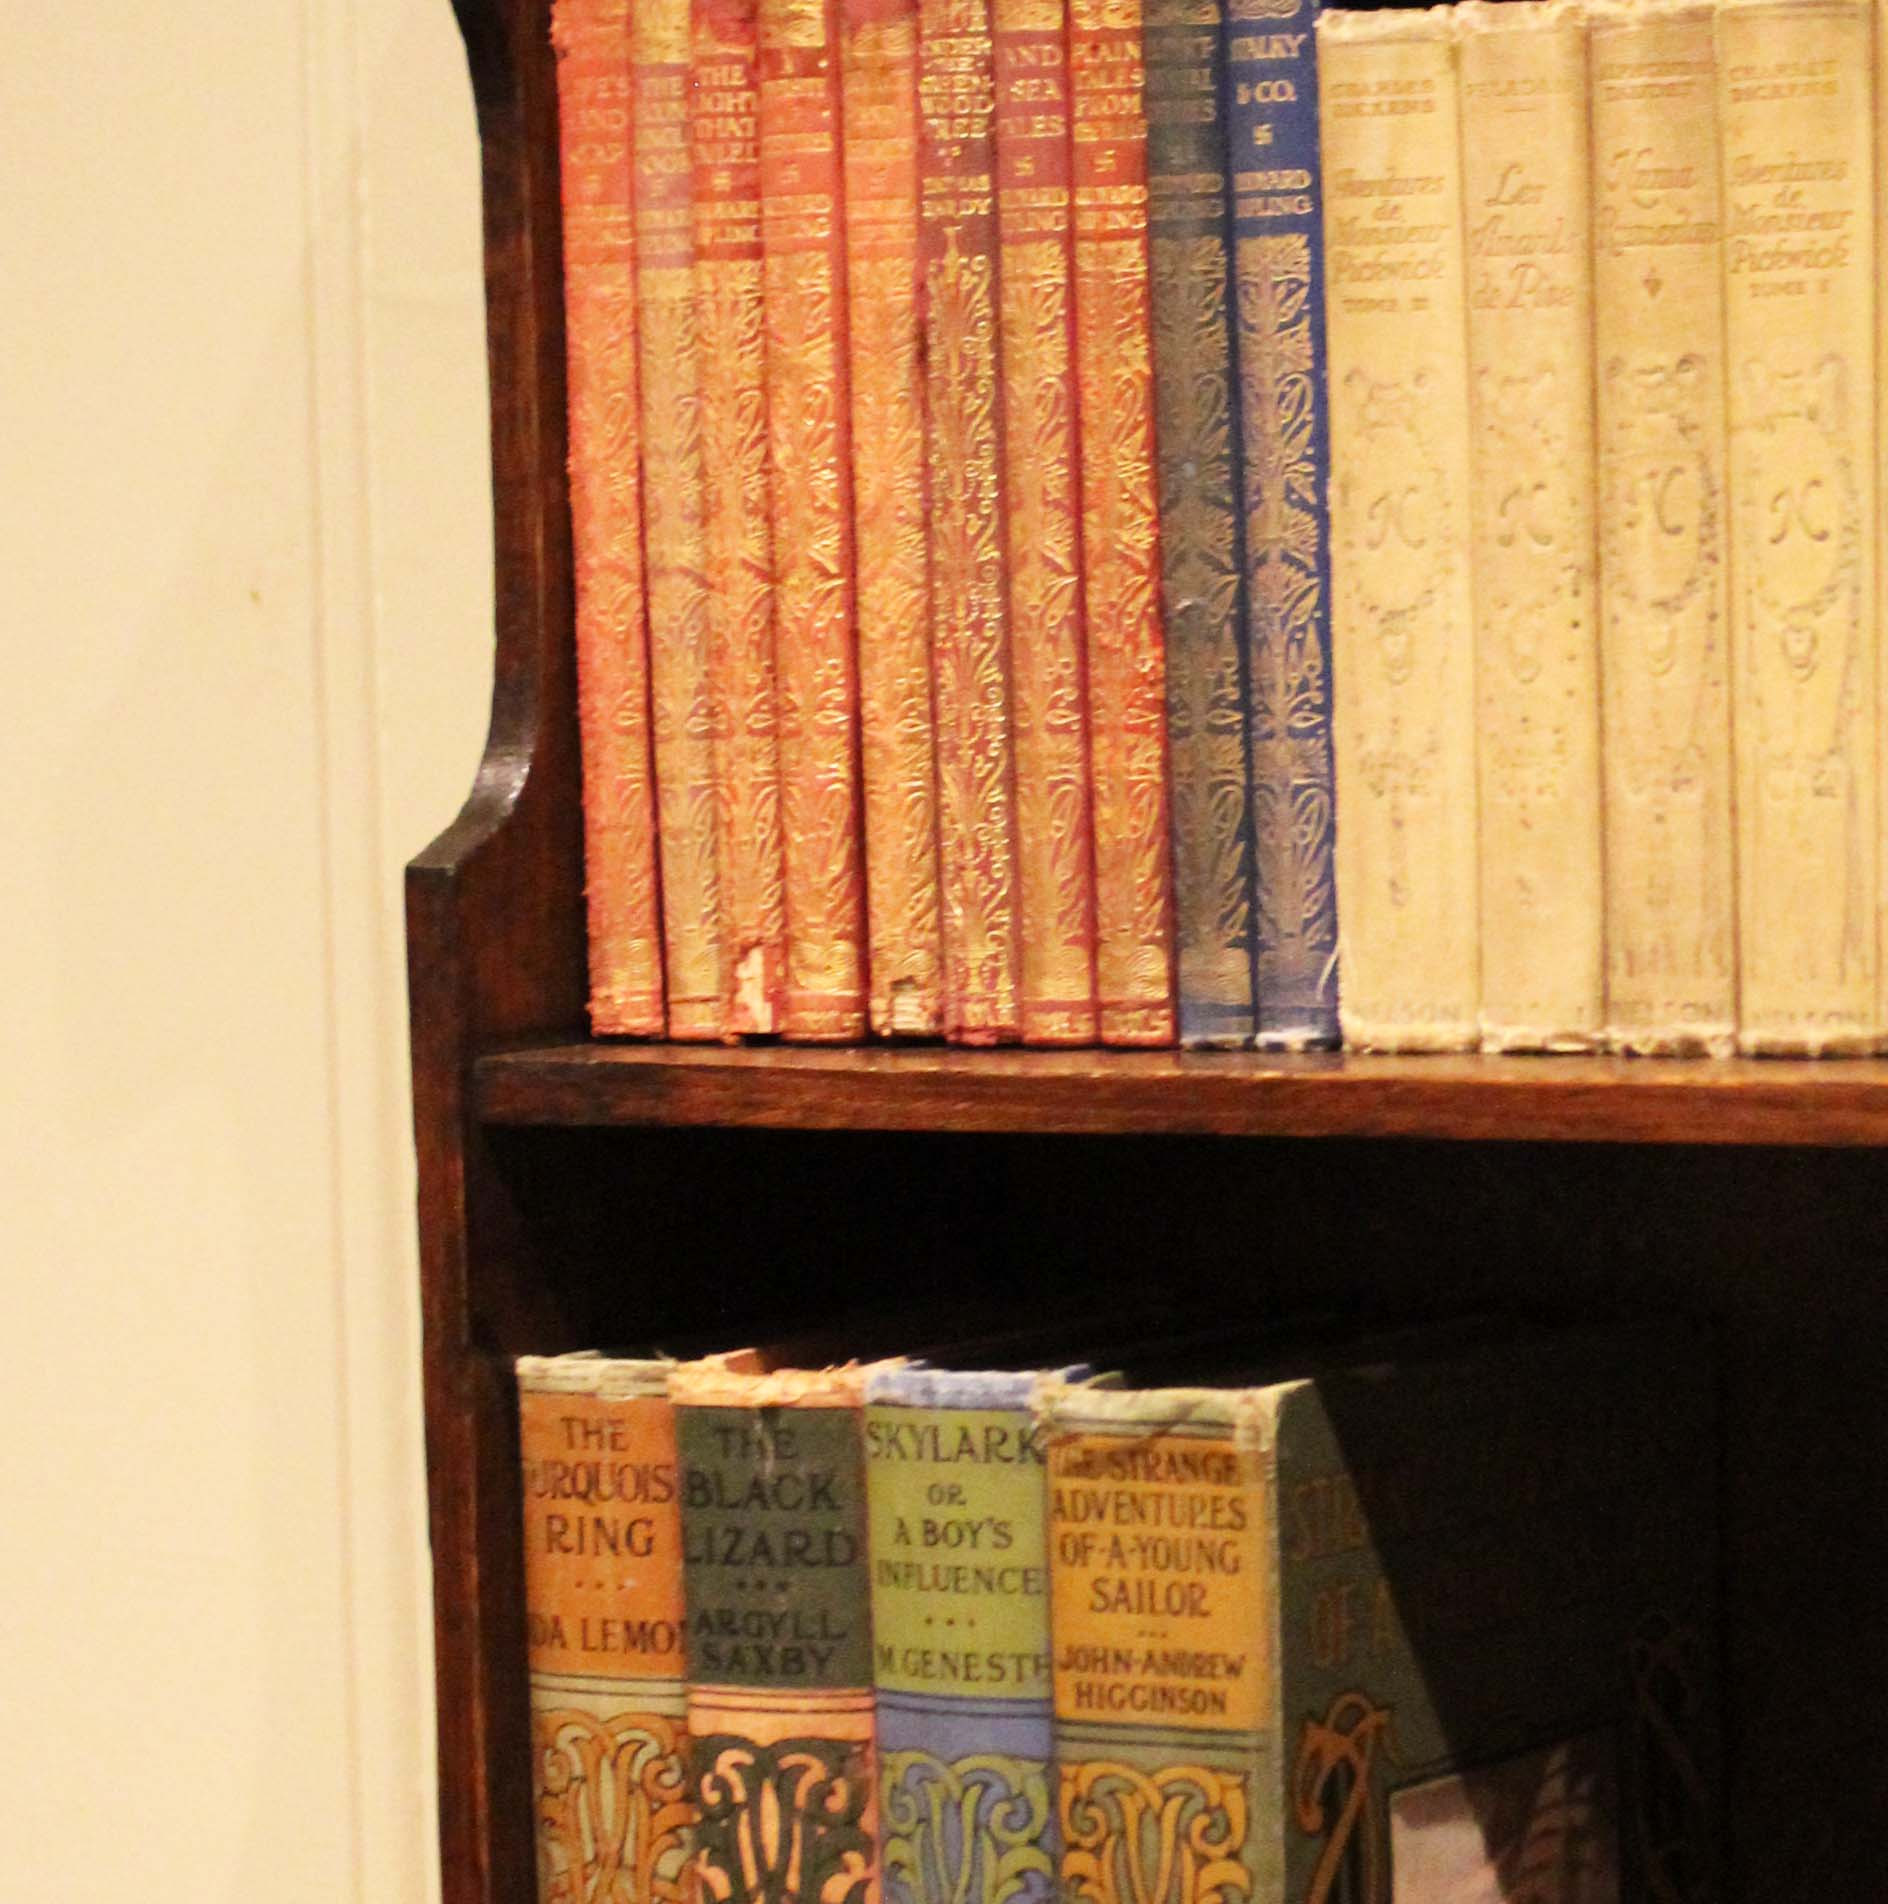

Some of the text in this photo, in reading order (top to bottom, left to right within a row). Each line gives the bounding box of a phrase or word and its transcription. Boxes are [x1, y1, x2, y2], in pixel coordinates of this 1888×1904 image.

[561, 1416, 630, 1452] THE
[714, 1422, 800, 1461] THE
[865, 1419, 1048, 1465] SKYLARK
[527, 1457, 676, 1507] URQUOIS
[684, 1467, 843, 1512] BLACK
[926, 1483, 968, 1507] OR
[1052, 1488, 1247, 1531] ADVENTURES
[546, 1514, 654, 1558] RING
[683, 1526, 858, 1568] LIZARD
[894, 1517, 1014, 1550] A BOY'S
[876, 1559, 1044, 1596] INFLUENCE
[1089, 1578, 1213, 1619] SAILOR
[701, 1645, 836, 1676] SAXBY
[1074, 1682, 1228, 1716] HIGGINSON
